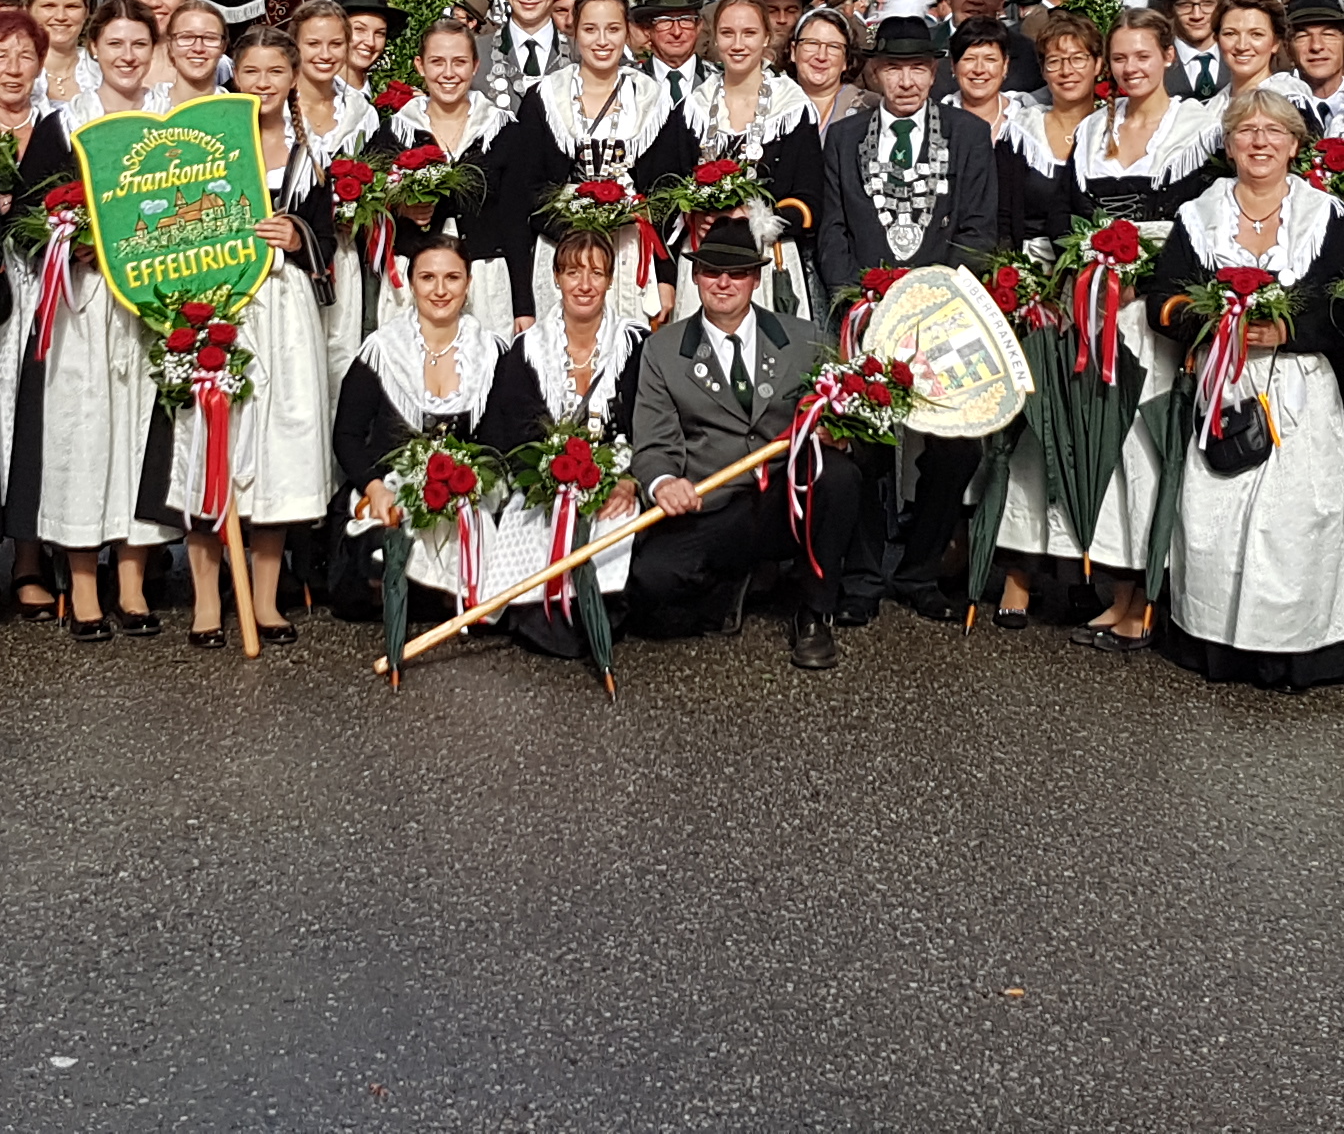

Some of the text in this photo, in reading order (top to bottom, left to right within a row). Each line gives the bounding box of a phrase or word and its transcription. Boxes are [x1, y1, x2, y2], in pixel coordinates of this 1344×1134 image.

[122, 127, 226, 169] Schützenverein
[125, 235, 257, 288] EFFELTRICH
[963, 278, 1027, 382] OBERFRANKEN
